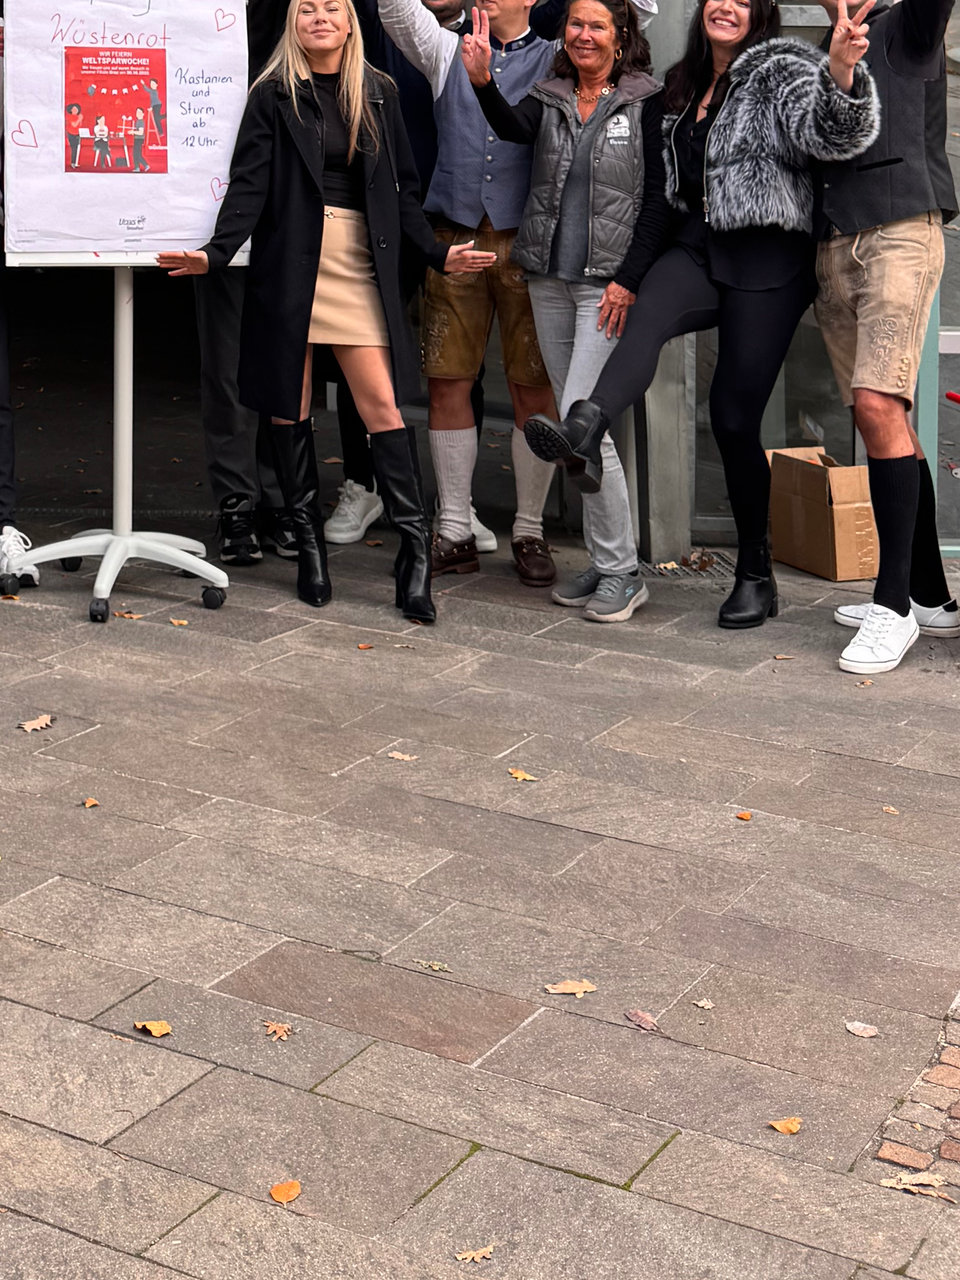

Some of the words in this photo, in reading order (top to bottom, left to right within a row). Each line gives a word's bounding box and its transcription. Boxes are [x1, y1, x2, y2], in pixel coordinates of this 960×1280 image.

[175, 67, 232, 84] Kastanien
[191, 85, 210, 97] und
[179, 101, 215, 115] Sturm
[192, 117, 206, 128] ab
[181, 135, 195, 147] 12
[198, 136, 218, 147] Uhr
